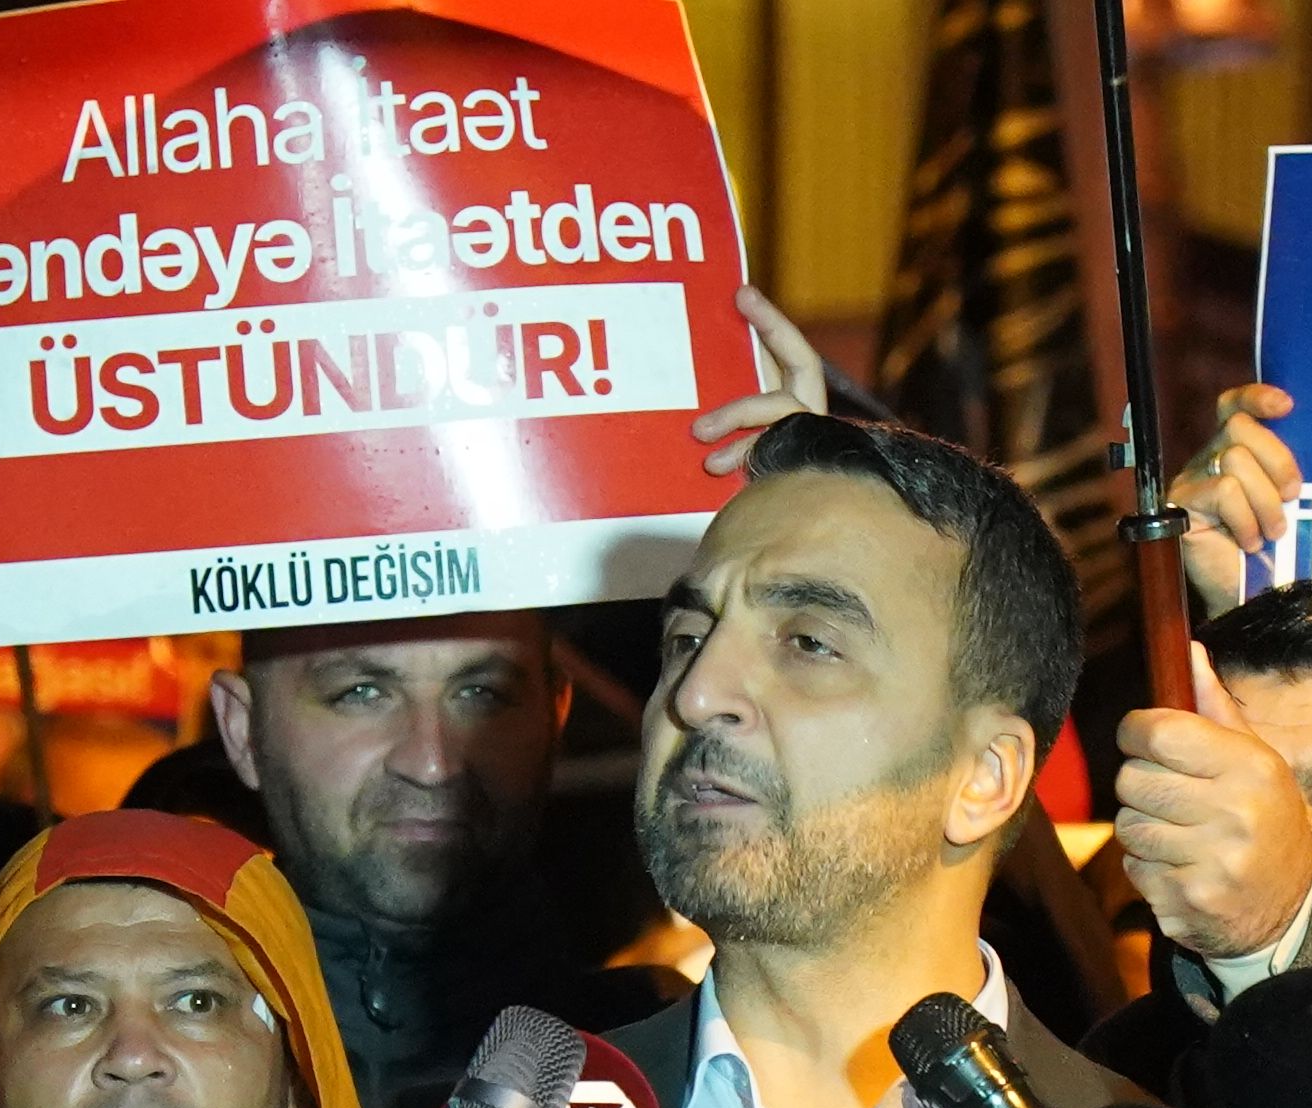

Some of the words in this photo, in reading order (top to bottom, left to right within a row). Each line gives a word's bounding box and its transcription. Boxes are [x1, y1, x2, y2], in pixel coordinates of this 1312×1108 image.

[63, 87, 325, 183] Allaha
[29, 300, 613, 436] ÜSTÜNDÜR!
[190, 551, 313, 614] KÖKLÜ
[324, 541, 481, 604] DEĞİŞİM
